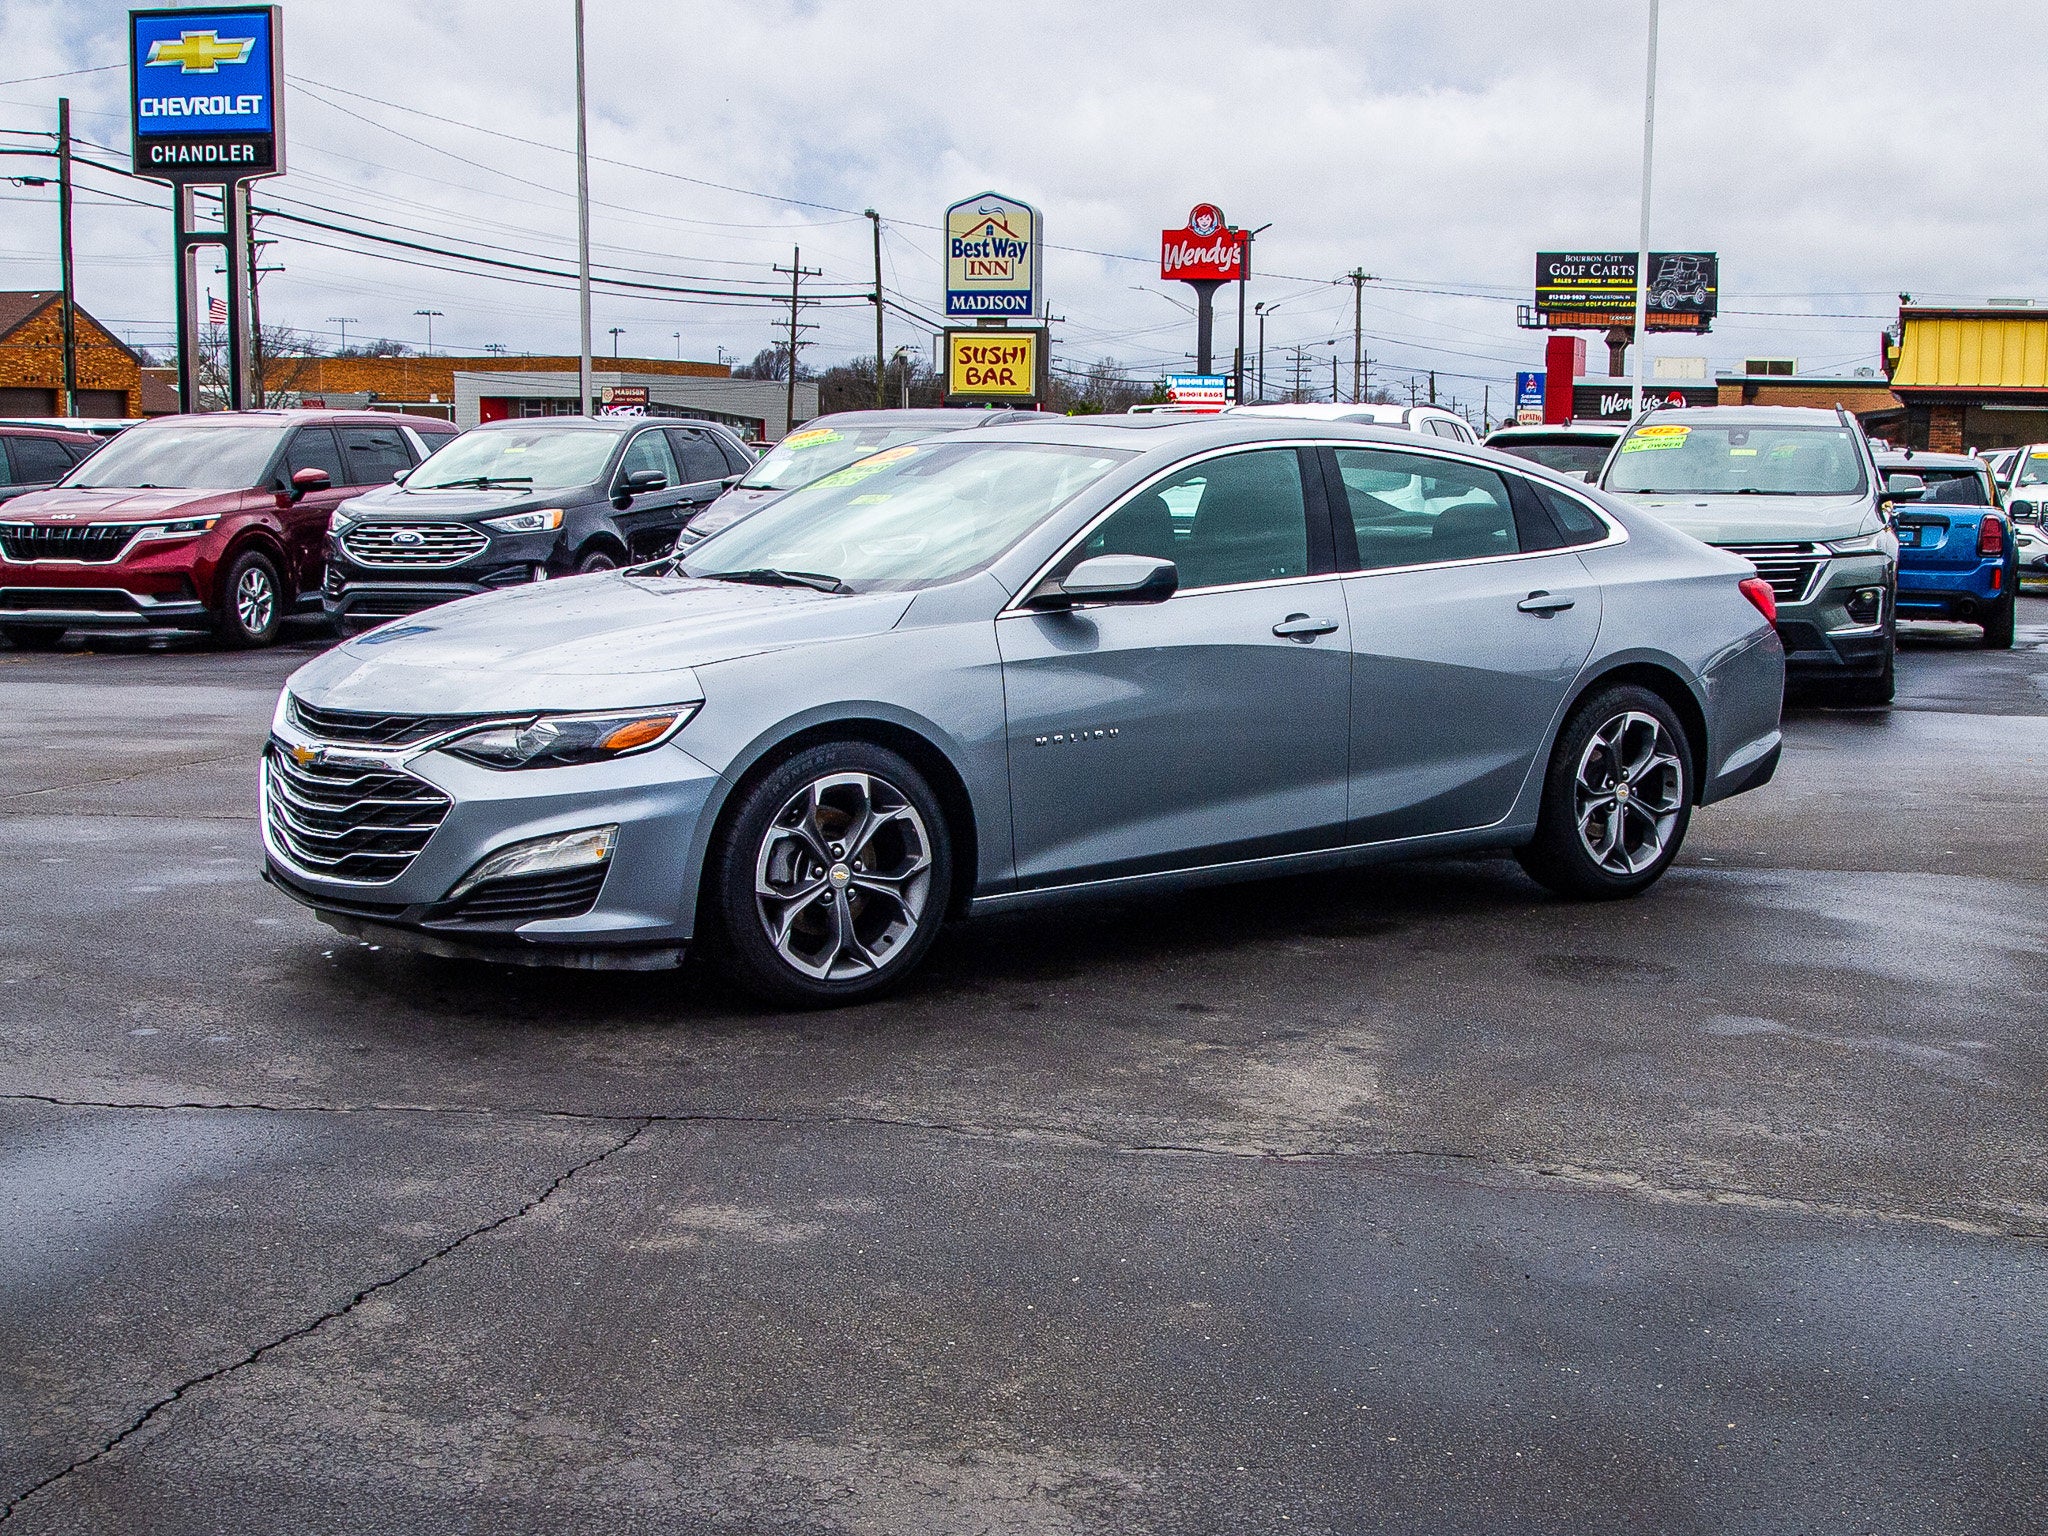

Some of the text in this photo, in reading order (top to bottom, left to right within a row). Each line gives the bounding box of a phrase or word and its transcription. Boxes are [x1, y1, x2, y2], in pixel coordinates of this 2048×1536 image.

[140, 95, 263, 117] CHEVROLET
[151, 145, 255, 162] CHANDLER
[951, 238, 1029, 264] Best Way
[1164, 236, 1241, 272] Wendy's
[968, 260, 1009, 275] INN
[951, 296, 1028, 310] MADISON
[958, 346, 1026, 365] SUSHI
[965, 367, 1017, 386] BAR
[1601, 393, 1660, 415] Weny's
[1035, 728, 1119, 746] MALIBU
